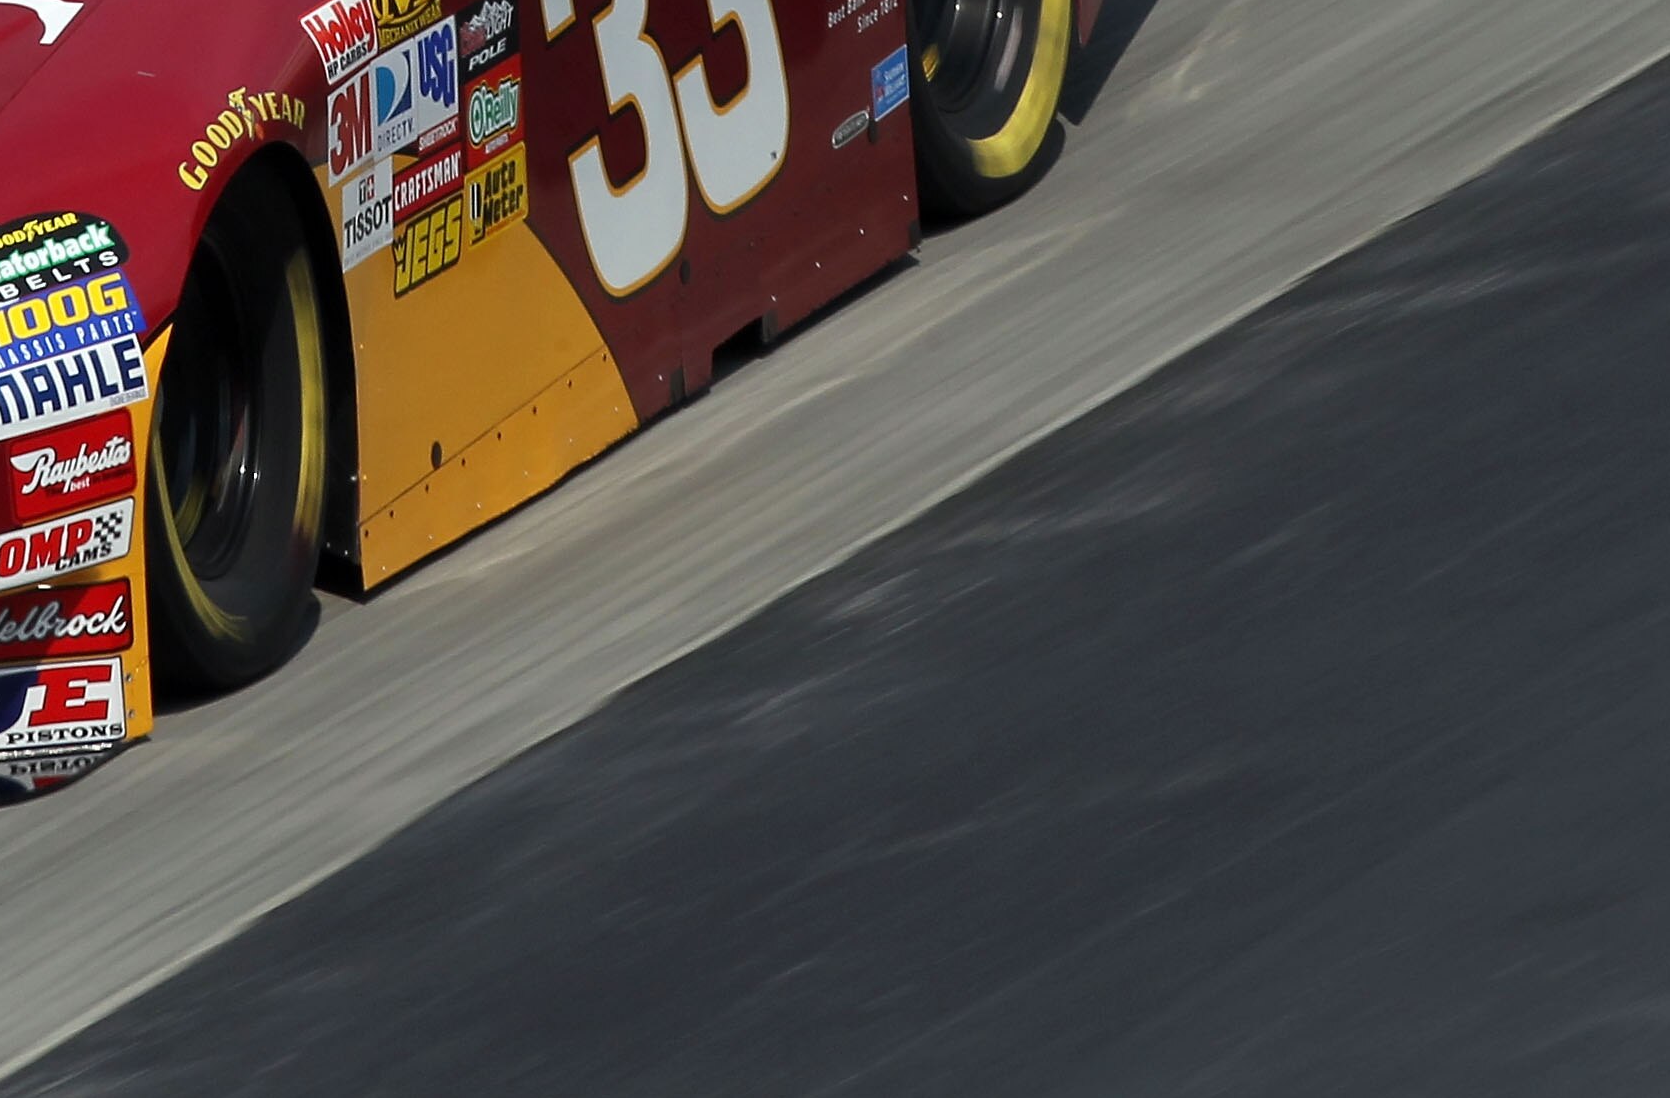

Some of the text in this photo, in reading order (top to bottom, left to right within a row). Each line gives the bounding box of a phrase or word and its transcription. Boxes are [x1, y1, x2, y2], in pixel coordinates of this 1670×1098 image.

[828, 5, 845, 28] Best
[340, 42, 368, 71] CARBS
[417, 23, 456, 109] USG
[469, 37, 507, 71] POLE
[330, 70, 372, 176] 3M
[470, 82, 519, 144] O'Reilly
[178, 86, 305, 190] GOODYEAR
[394, 151, 460, 212] CRAFTSMAN
[484, 159, 516, 199] Auto
[344, 195, 393, 249] TISSOT
[484, 184, 524, 228] Meter
[395, 197, 462, 295] JEGS
[76, 312, 134, 345] PARTS
[10, 435, 132, 495] Raybestos
[55, 542, 113, 572] CAMS
[6, 722, 124, 746] PISTONS
